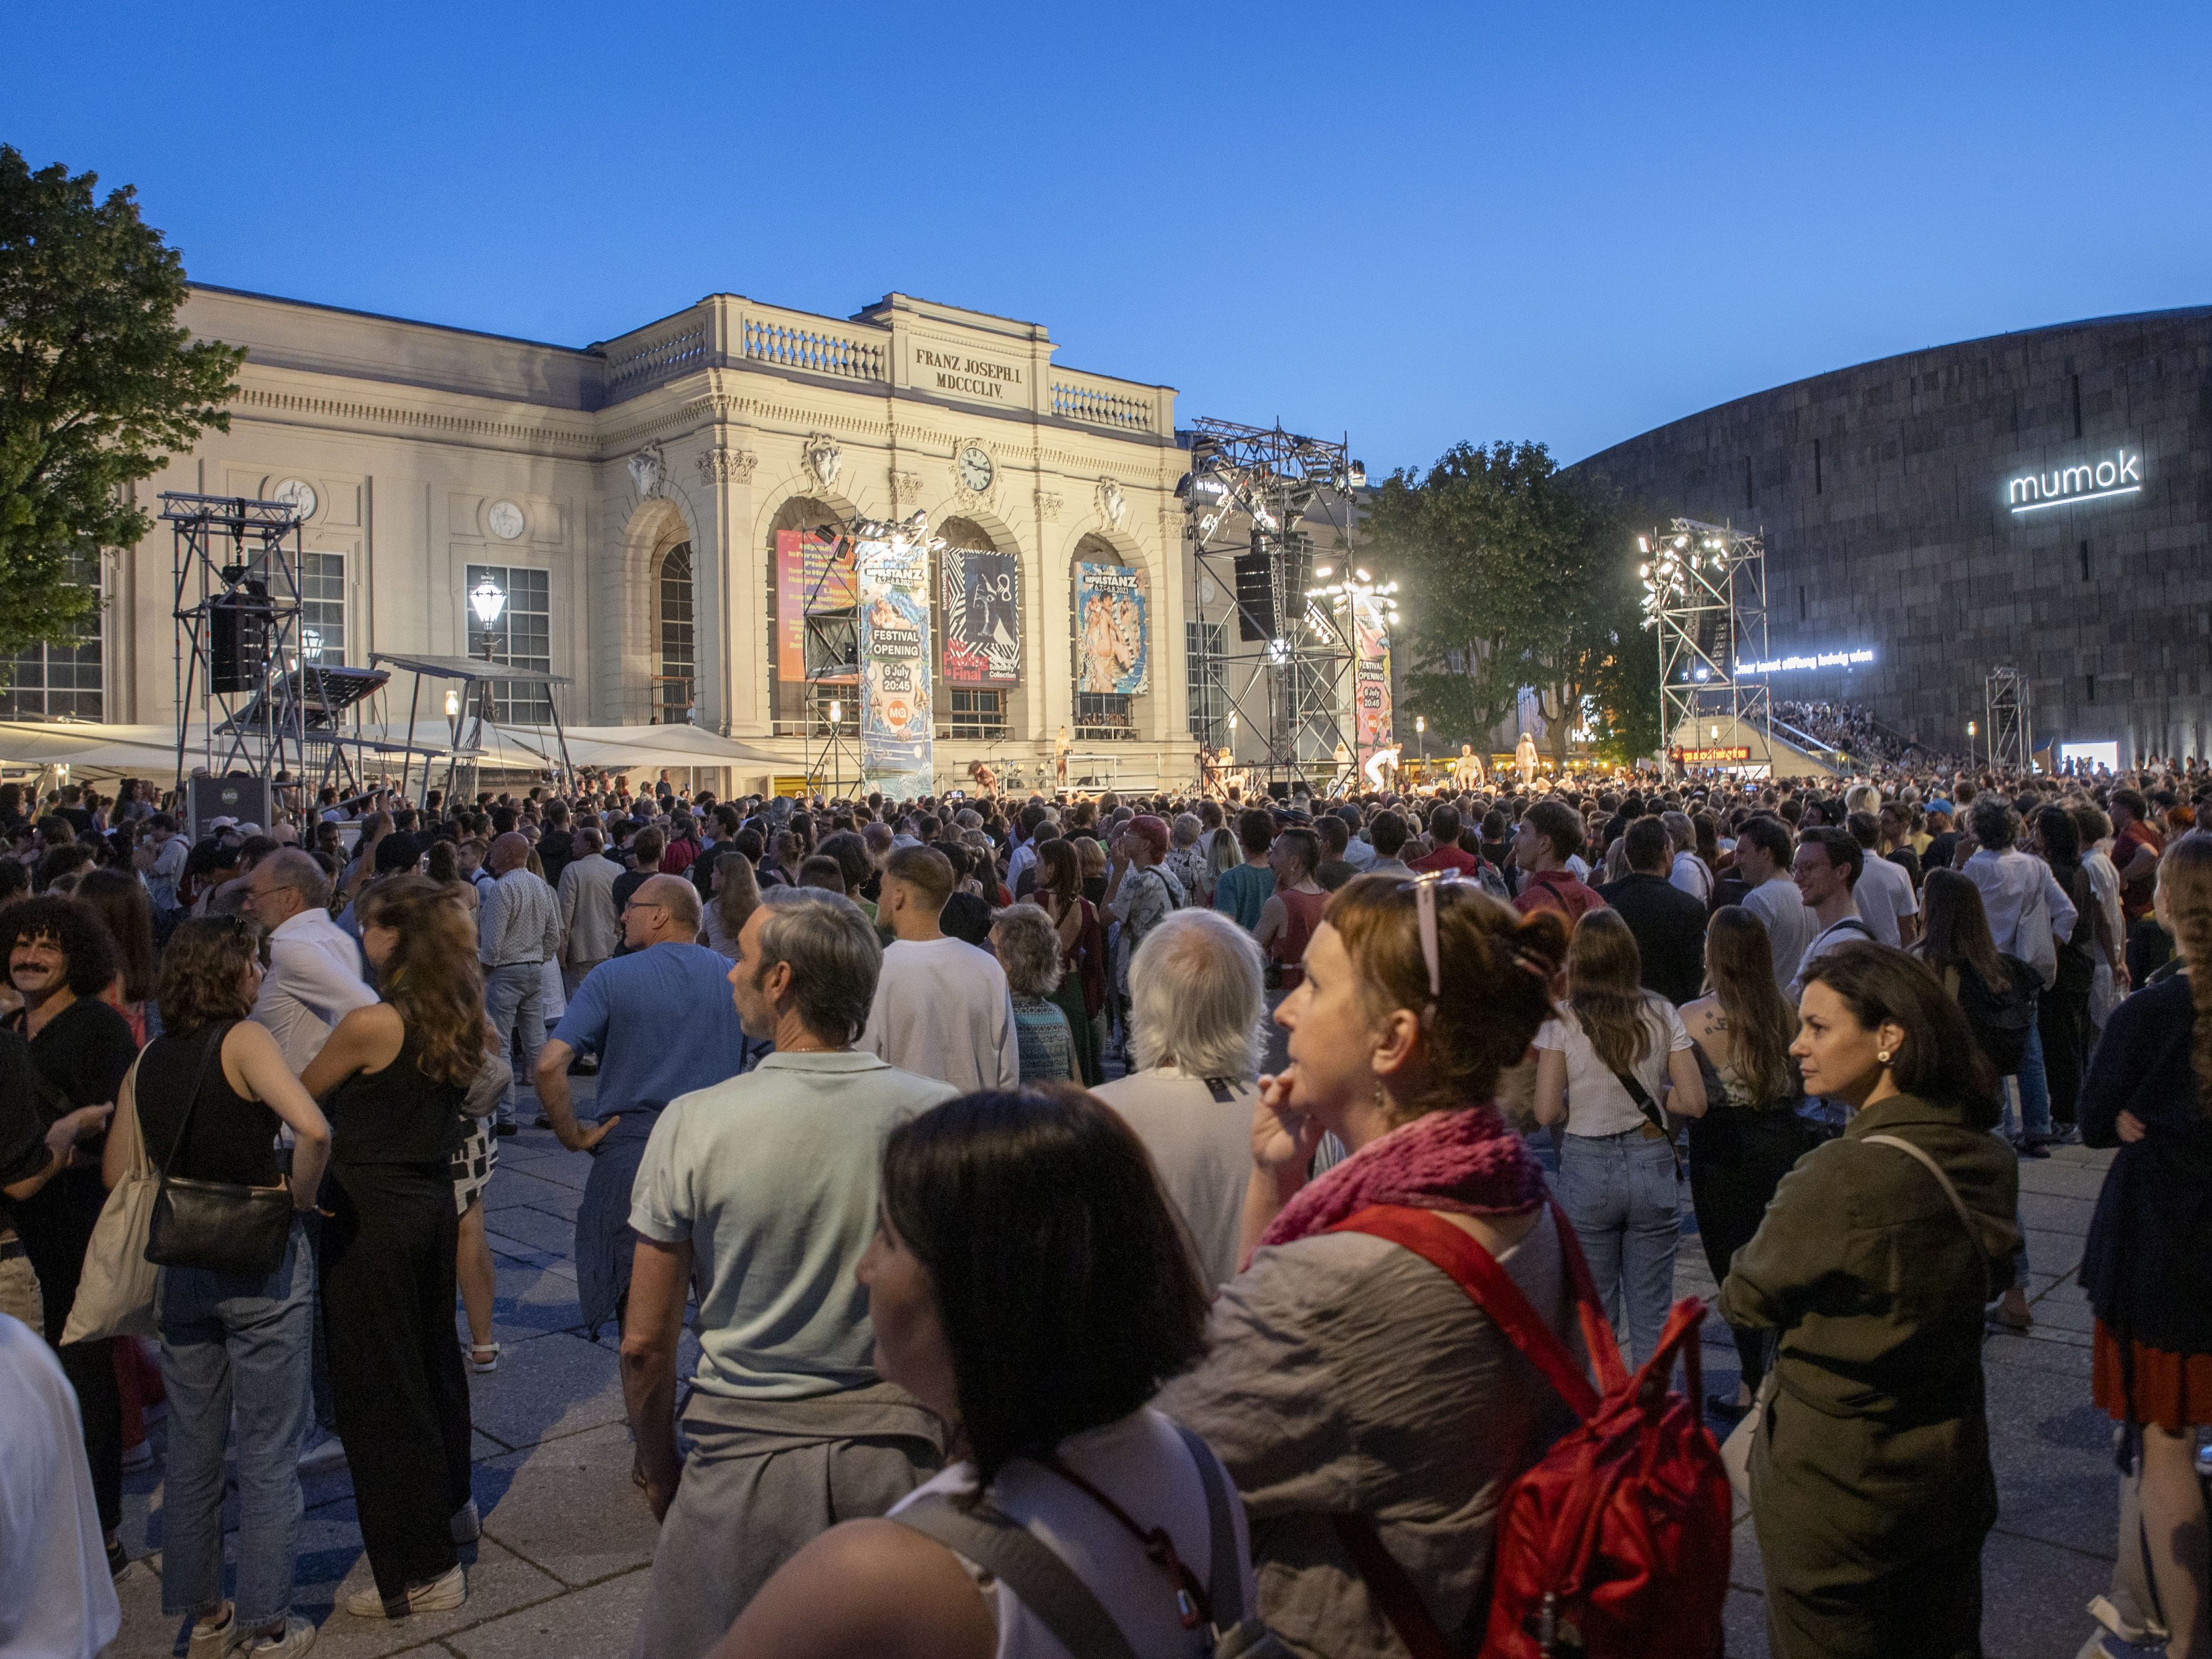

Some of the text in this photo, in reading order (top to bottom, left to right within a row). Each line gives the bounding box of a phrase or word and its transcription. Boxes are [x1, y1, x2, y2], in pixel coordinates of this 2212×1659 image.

[916, 349, 960, 371] FRANZ
[936, 372, 1003, 399] MDCCCLIV.
[2010, 449, 2139, 503] mumok
[1085, 576, 1137, 588] IMPULSTANZ
[873, 629, 919, 642] FESTIVAL
[873, 644, 918, 656] OPENING
[947, 638, 966, 652] No
[1359, 660, 1383, 670] FESTIVAL
[885, 666, 909, 678] 6 July
[952, 666, 981, 681] Final
[1359, 672, 1384, 681] OPENING
[885, 680, 910, 691] 20:45
[1369, 688, 1380, 698] July
[889, 707, 907, 718] MQ
